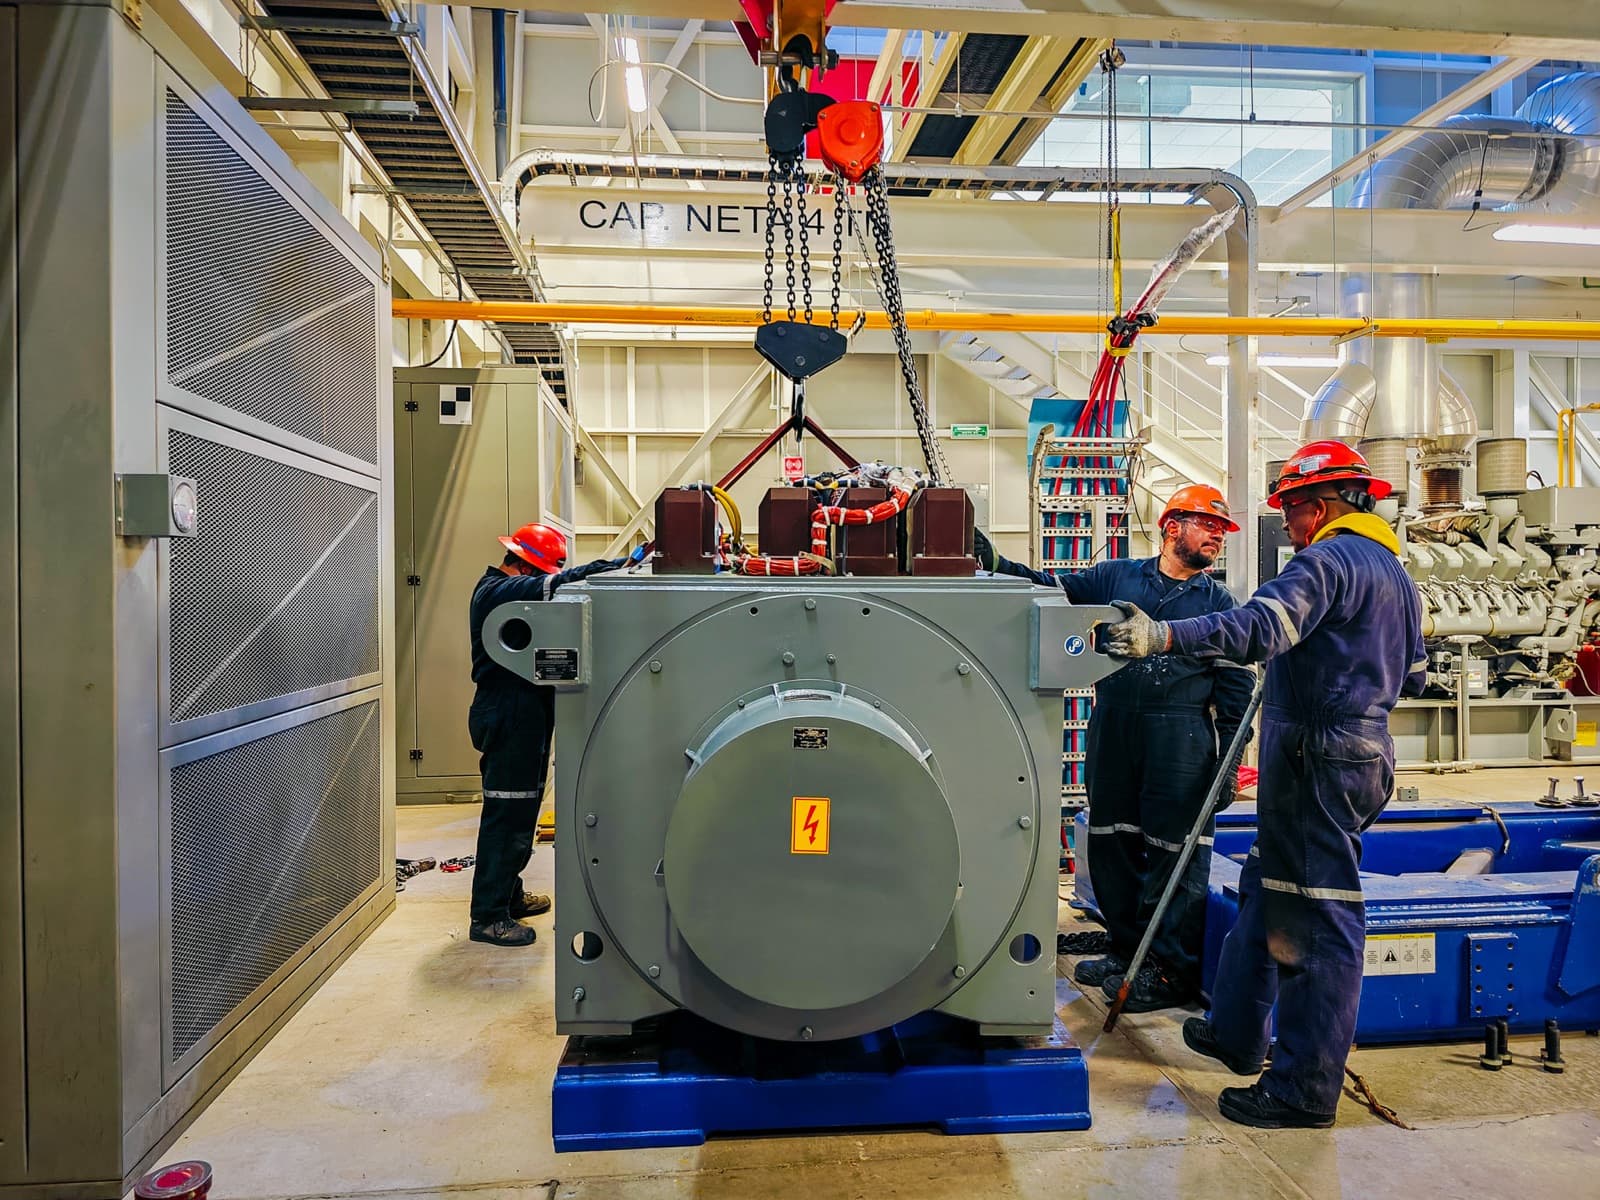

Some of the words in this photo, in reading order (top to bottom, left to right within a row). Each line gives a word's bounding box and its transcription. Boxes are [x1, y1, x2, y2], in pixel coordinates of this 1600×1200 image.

[579, 200, 668, 230] CAP.
[687, 204, 792, 235] NETA
[805, 208, 825, 236] 4
